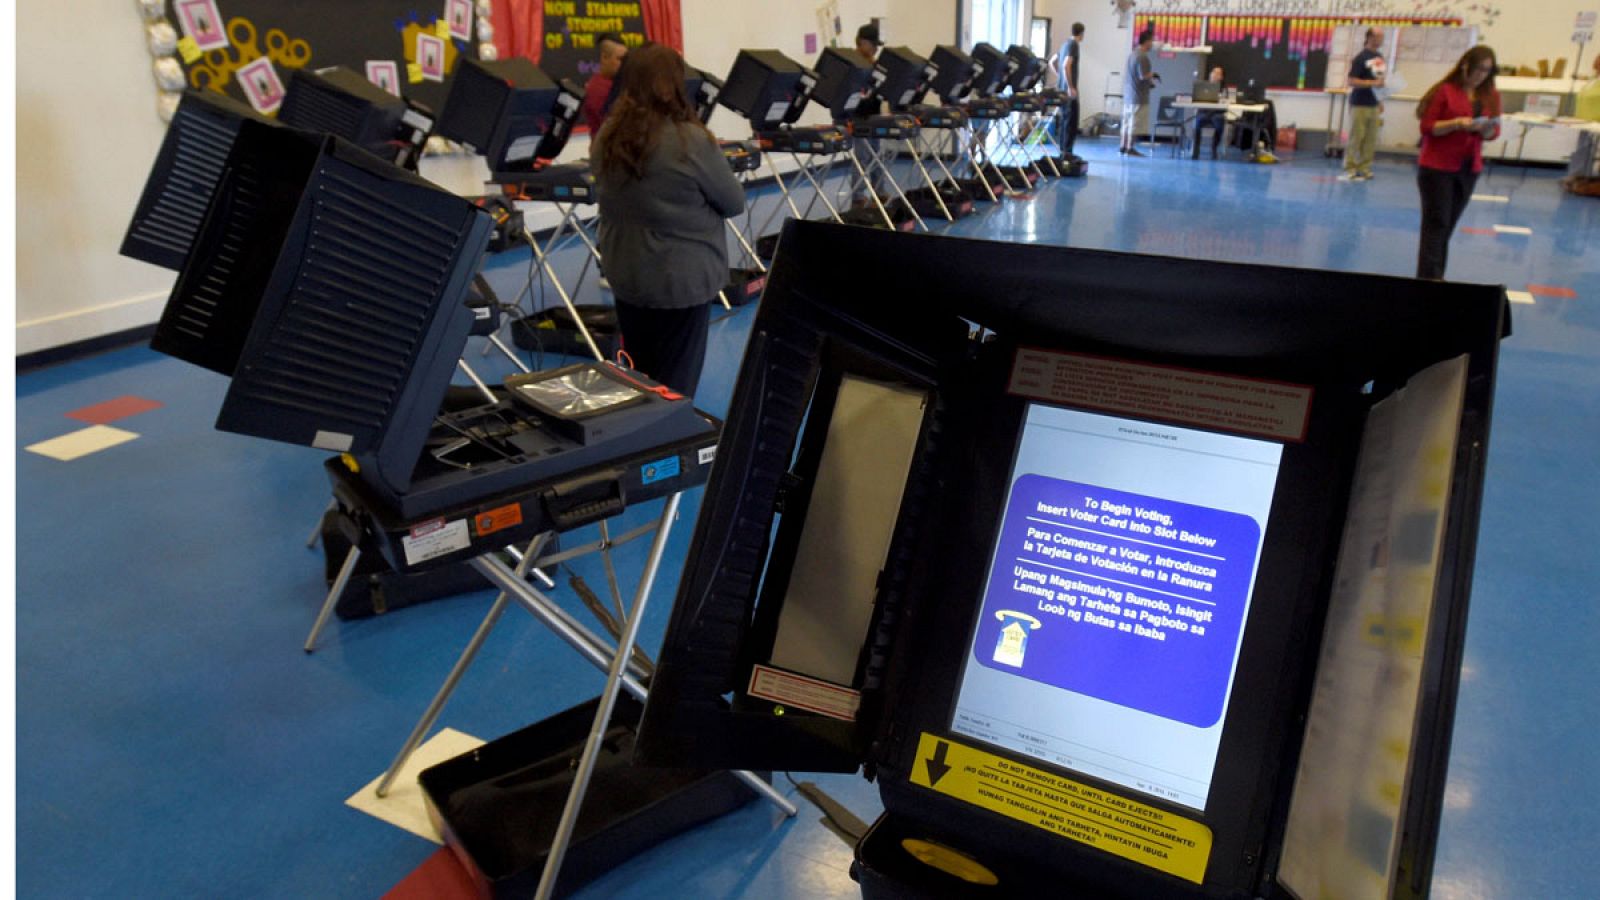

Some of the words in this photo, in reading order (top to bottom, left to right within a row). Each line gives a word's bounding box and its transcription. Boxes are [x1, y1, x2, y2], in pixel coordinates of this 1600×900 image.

[543, 1, 576, 16] NOW
[566, 17, 624, 32] STUDENTS
[545, 32, 563, 48] OF
[570, 33, 594, 48] THE
[1037, 502, 1068, 517] Insert
[1070, 510, 1099, 524] Voter
[1100, 515, 1127, 529] Card
[1129, 523, 1152, 533] Into
[1154, 526, 1178, 540] Slot
[1180, 531, 1216, 548] Below
[1085, 497, 1099, 509] To
[1101, 499, 1132, 516] Begin
[1135, 507, 1173, 526] Voting,
[1023, 540, 1032, 552] la
[1036, 542, 1072, 561] Tarjeta
[1075, 550, 1088, 563] de
[1091, 554, 1138, 575] Votación
[1141, 568, 1155, 578] en
[1157, 570, 1169, 581] la
[1171, 574, 1212, 592] Ranura
[1027, 527, 1051, 540] Para
[1053, 532, 1107, 554] Comenzar
[1120, 548, 1152, 565] Votar,
[1156, 555, 1216, 578] Introduzca
[1013, 566, 1046, 584] Upang
[1050, 572, 1122, 602] Magsimula'ng
[1125, 592, 1173, 614] Bumoto,
[1176, 603, 1213, 622] Isingit
[1013, 580, 1054, 600] Lamang
[1056, 591, 1077, 606] ang
[1080, 595, 1121, 614] Tarheta
[1123, 607, 1137, 618] sa
[1140, 610, 1188, 633] Pagboto
[1191, 625, 1205, 636] sa
[1038, 600, 1065, 615] Loob
[1068, 609, 1081, 622] ng
[1084, 612, 1116, 630] Butas
[1118, 621, 1132, 631] sa
[1134, 623, 1166, 641] Ibaba
[978, 768, 999, 781] QUITE
[1000, 776, 1009, 784] LA
[1011, 779, 1042, 798] TARJETA
[1044, 790, 1069, 806] HASTA
[1070, 799, 1086, 811] QUE
[1088, 804, 1112, 820] SALGA
[998, 761, 1009, 770] DO
[1011, 764, 1025, 774] NOT
[1027, 768, 1056, 784] REMOVE
[1057, 778, 1080, 792] CARD,
[1081, 786, 1102, 799] UNTIL
[1105, 794, 1127, 808] CARD
[1129, 800, 1164, 820] EJECTS!!
[1006, 797, 1047, 817] TANGGALIN
[1049, 810, 1065, 823] ANG
[1067, 816, 1102, 836] TARHETA,
[1104, 832, 1141, 851] HINTAYIN
[1143, 844, 1168, 859] IBUGA
[1040, 819, 1056, 830] ANG
[1058, 824, 1096, 843] TARHETA!!
